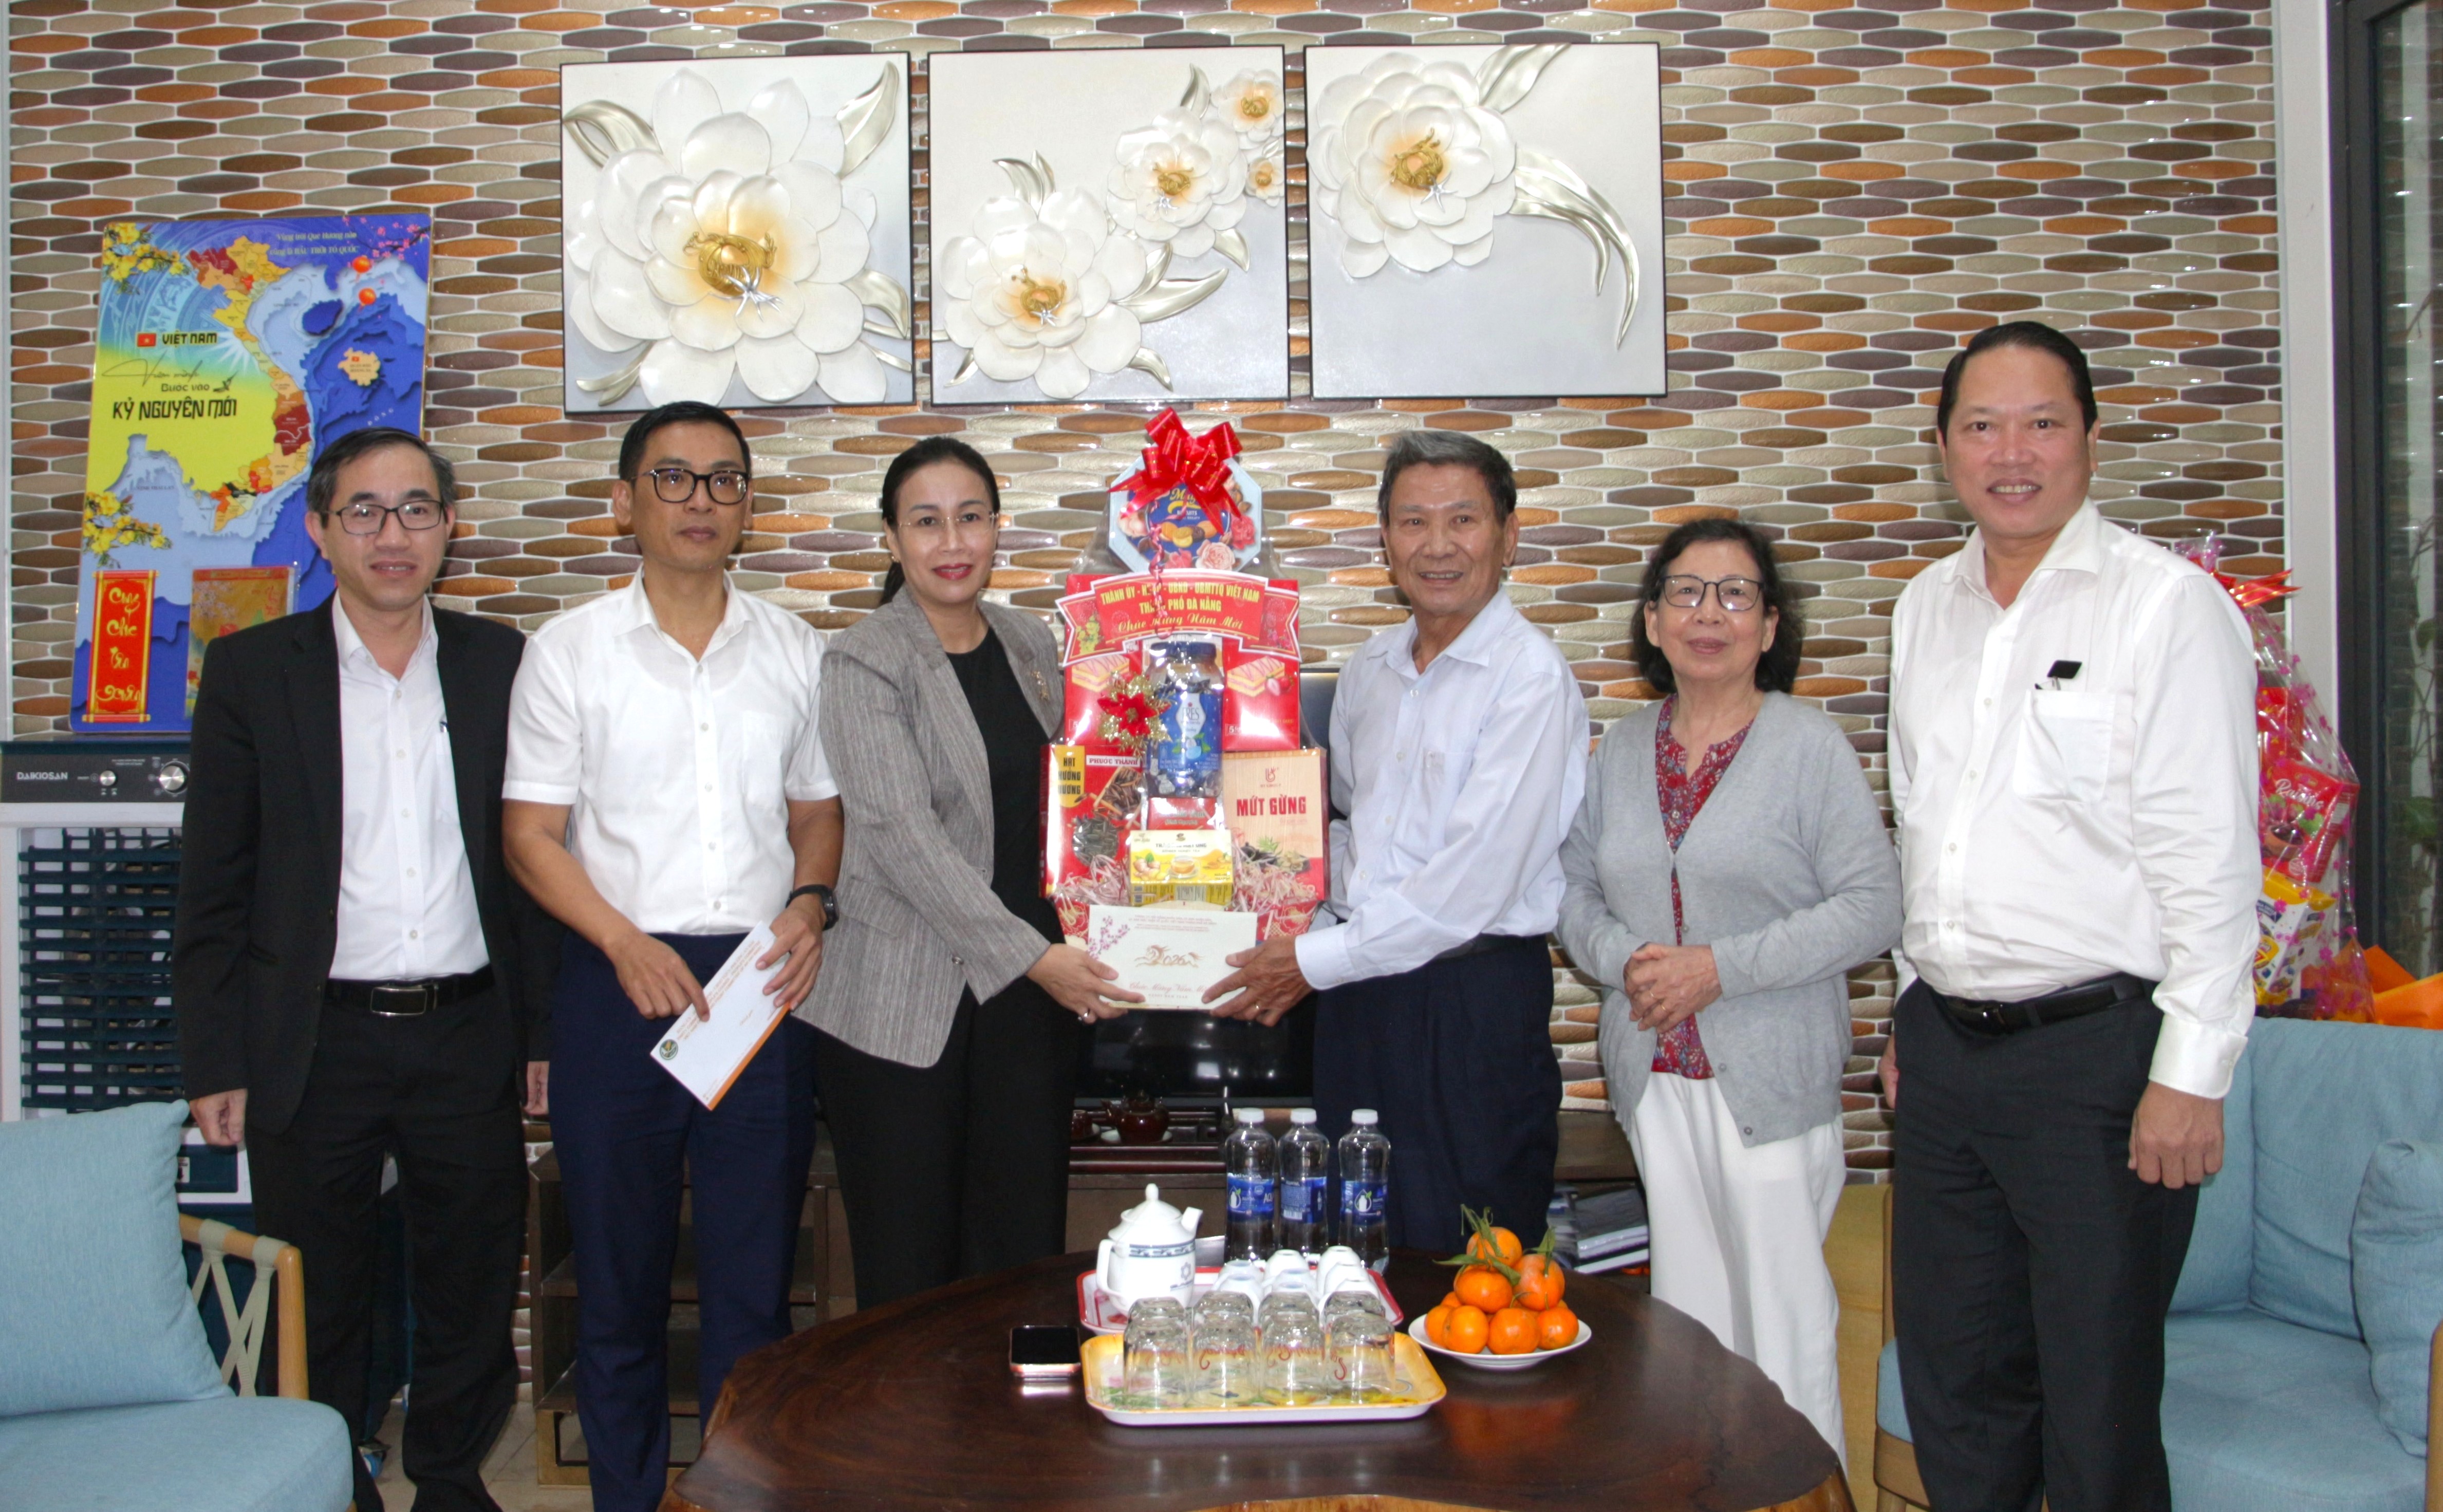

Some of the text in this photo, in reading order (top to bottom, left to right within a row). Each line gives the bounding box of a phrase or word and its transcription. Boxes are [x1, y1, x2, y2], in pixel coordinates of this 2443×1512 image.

[162, 329, 217, 348] VIỆT NAM
[139, 396, 204, 420] NGUYÊN
[208, 396, 237, 419] MỚI
[1101, 588, 1125, 605] THÀNH
[1168, 582, 1188, 593] UBND
[1195, 582, 1224, 596] UBMTTQ
[1226, 583, 1241, 599] VIỆT
[1242, 588, 1260, 603] NAM
[1168, 595, 1185, 610] PHỐ
[1200, 596, 1222, 612] NẴNG
[1187, 613, 1217, 624] Năm
[1220, 616, 1243, 629] Mới
[17, 772, 68, 780] DAIKIOSAN
[1237, 794, 1307, 816] MỨT GỪNG
